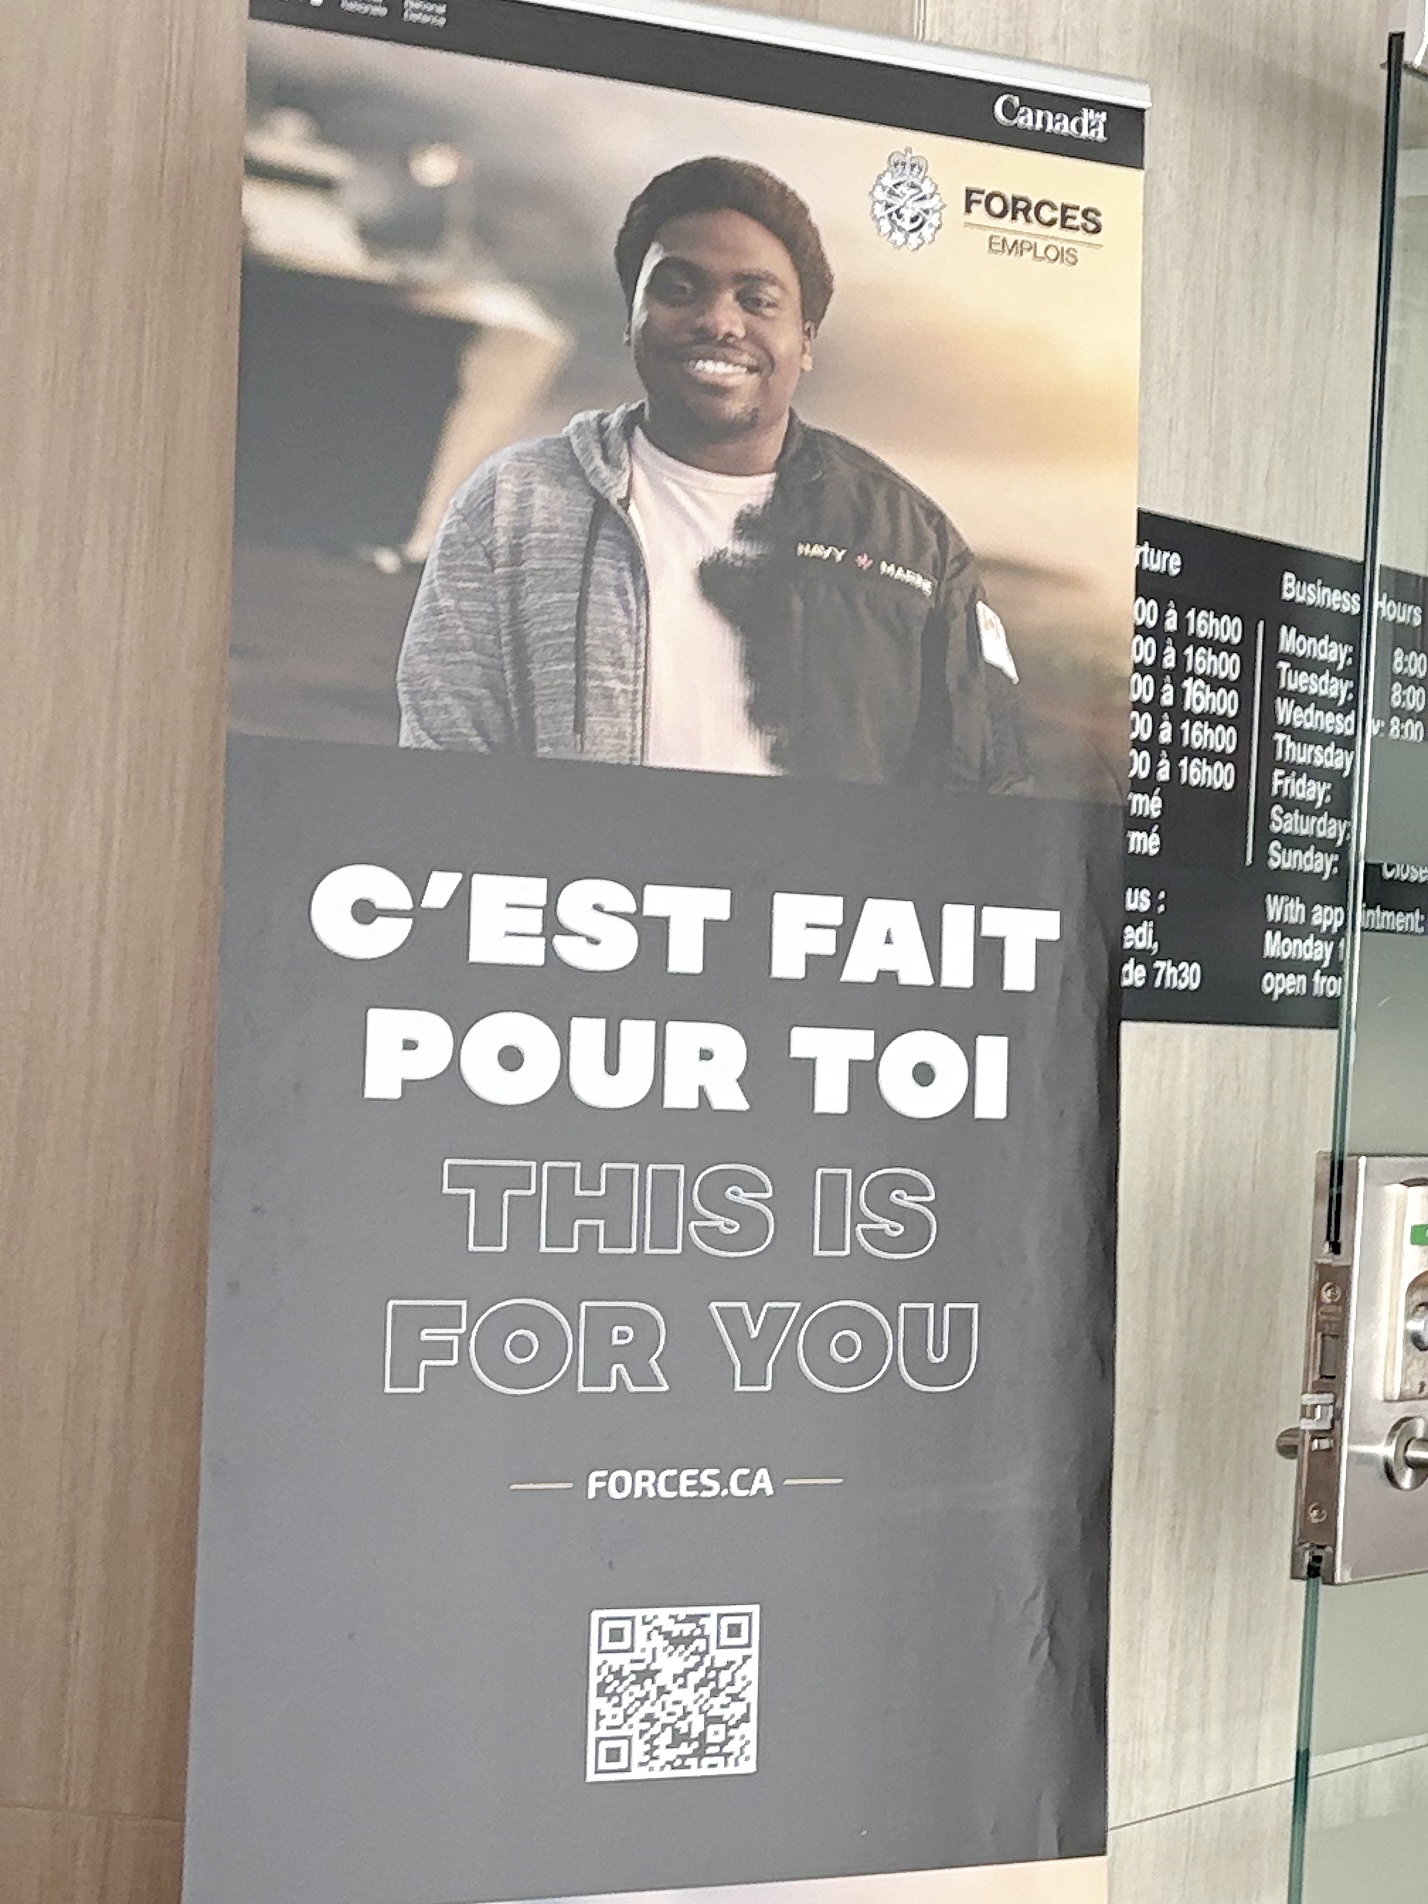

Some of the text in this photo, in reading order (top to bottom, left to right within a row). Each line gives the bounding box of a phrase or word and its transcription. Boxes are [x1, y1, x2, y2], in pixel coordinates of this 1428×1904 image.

[993, 93, 1108, 143] Canada
[963, 186, 1103, 235] FORCES
[987, 234, 1079, 266] EMPLOIS
[1280, 570, 1361, 615] Business
[1164, 600, 1178, 633] à
[1185, 607, 1242, 645] 16h00
[1162, 637, 1176, 670] à
[1183, 644, 1240, 682] 16h00
[1278, 624, 1354, 671] Monday:
[1392, 647, 1428, 679] 8:00
[1160, 674, 1174, 707] à
[1181, 676, 1239, 718] 16h00
[1276, 660, 1354, 707] Tuesday:
[1390, 681, 1426, 713] 8:00
[1158, 712, 1172, 745] à
[1180, 718, 1237, 755] 16h00
[1389, 715, 1425, 744] 8:00
[1156, 749, 1170, 783] à
[1178, 756, 1235, 791] 16h00
[1271, 768, 1332, 809] Friday:
[1127, 787, 1162, 819] mé
[1126, 824, 1161, 856] mé
[1269, 803, 1352, 847] Saturday:
[1267, 839, 1340, 882] Sunday:
[309, 863, 1061, 992] C'EST FAIT
[1265, 893, 1306, 925] With
[1263, 929, 1334, 969] Monday
[1152, 959, 1201, 990] 7h30
[1261, 971, 1307, 1002] open
[363, 1007, 1009, 1120] POUR TOI
[442, 1158, 938, 1260] THIS IS
[383, 1298, 980, 1395] FOR YOU
[586, 1466, 775, 1499] FORCES.CA
